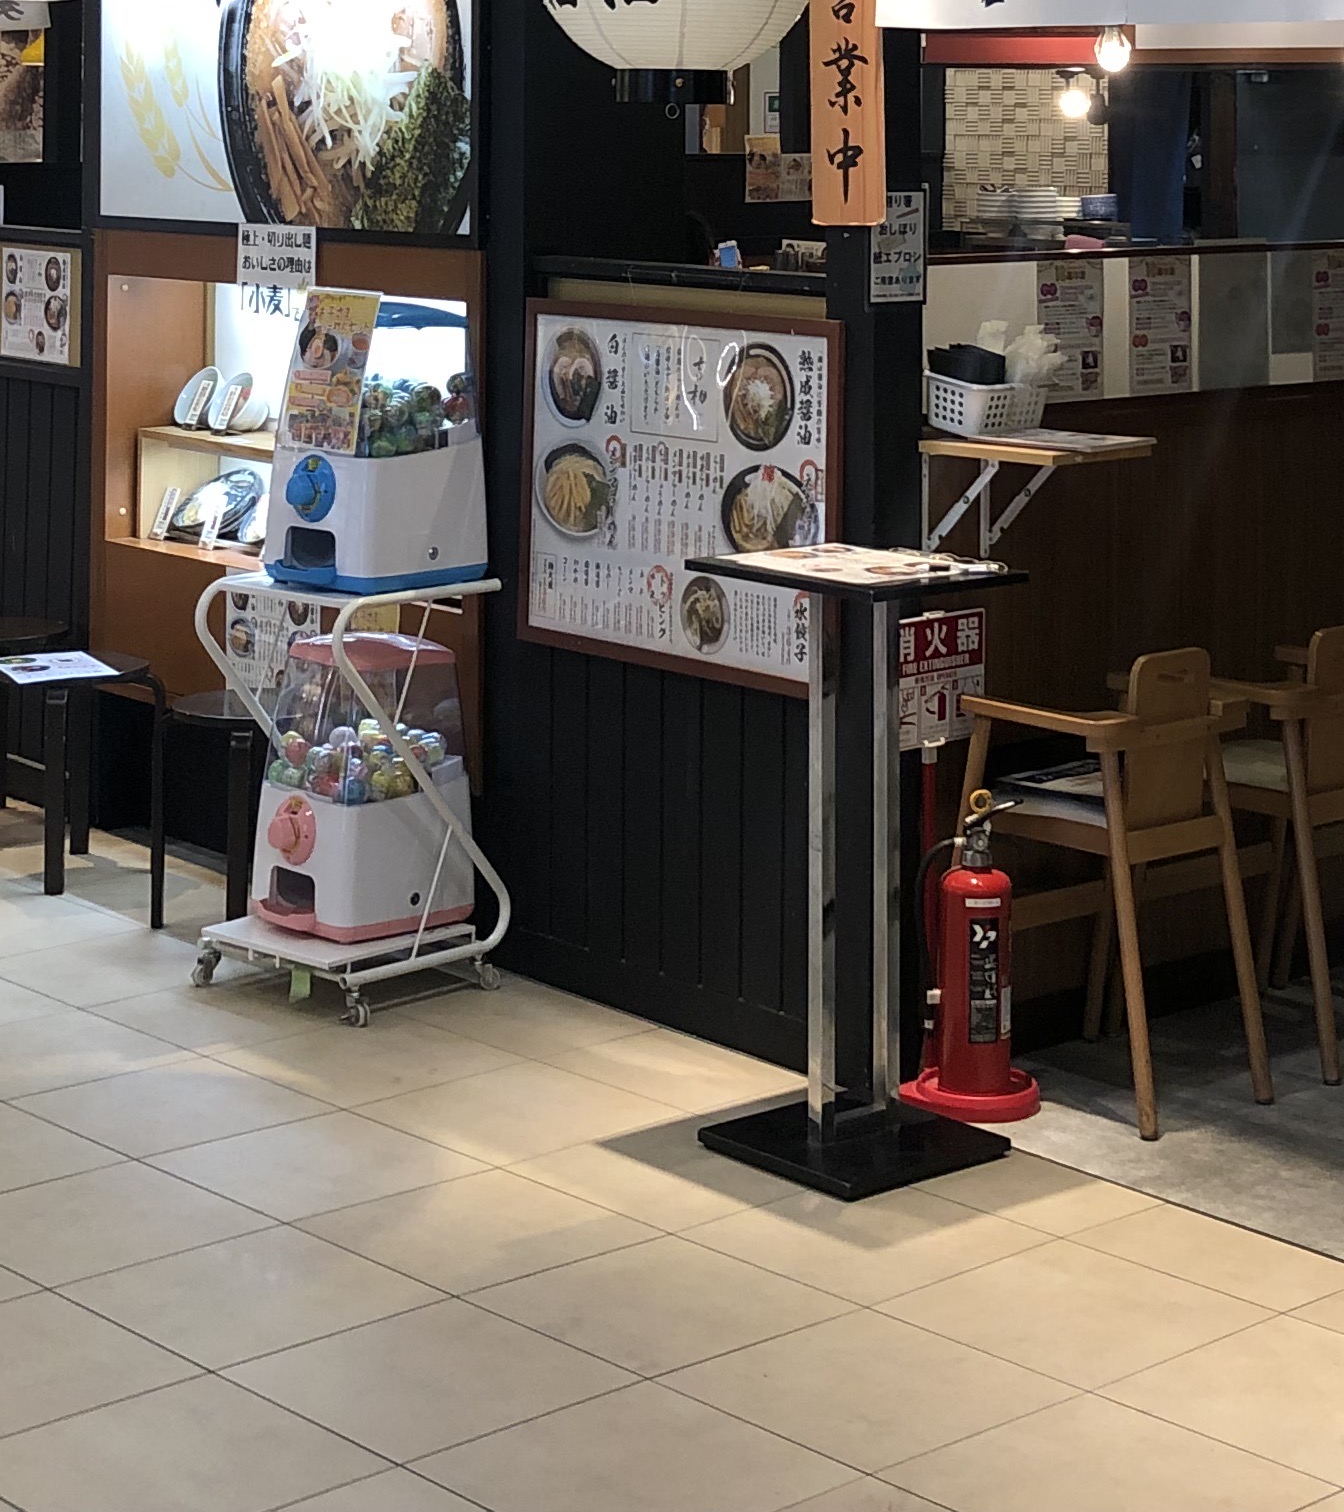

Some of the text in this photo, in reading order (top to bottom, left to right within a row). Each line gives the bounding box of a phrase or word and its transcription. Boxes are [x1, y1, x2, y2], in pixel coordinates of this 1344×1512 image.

[878, 222, 917, 236] おしぼり
[241, 255, 312, 274] おいしさの理由は
[604, 333, 620, 425] 白醤油
[796, 349, 815, 446] 熟成醤油
[793, 601, 808, 663] 水餃子
[902, 662, 918, 676] FIRE
